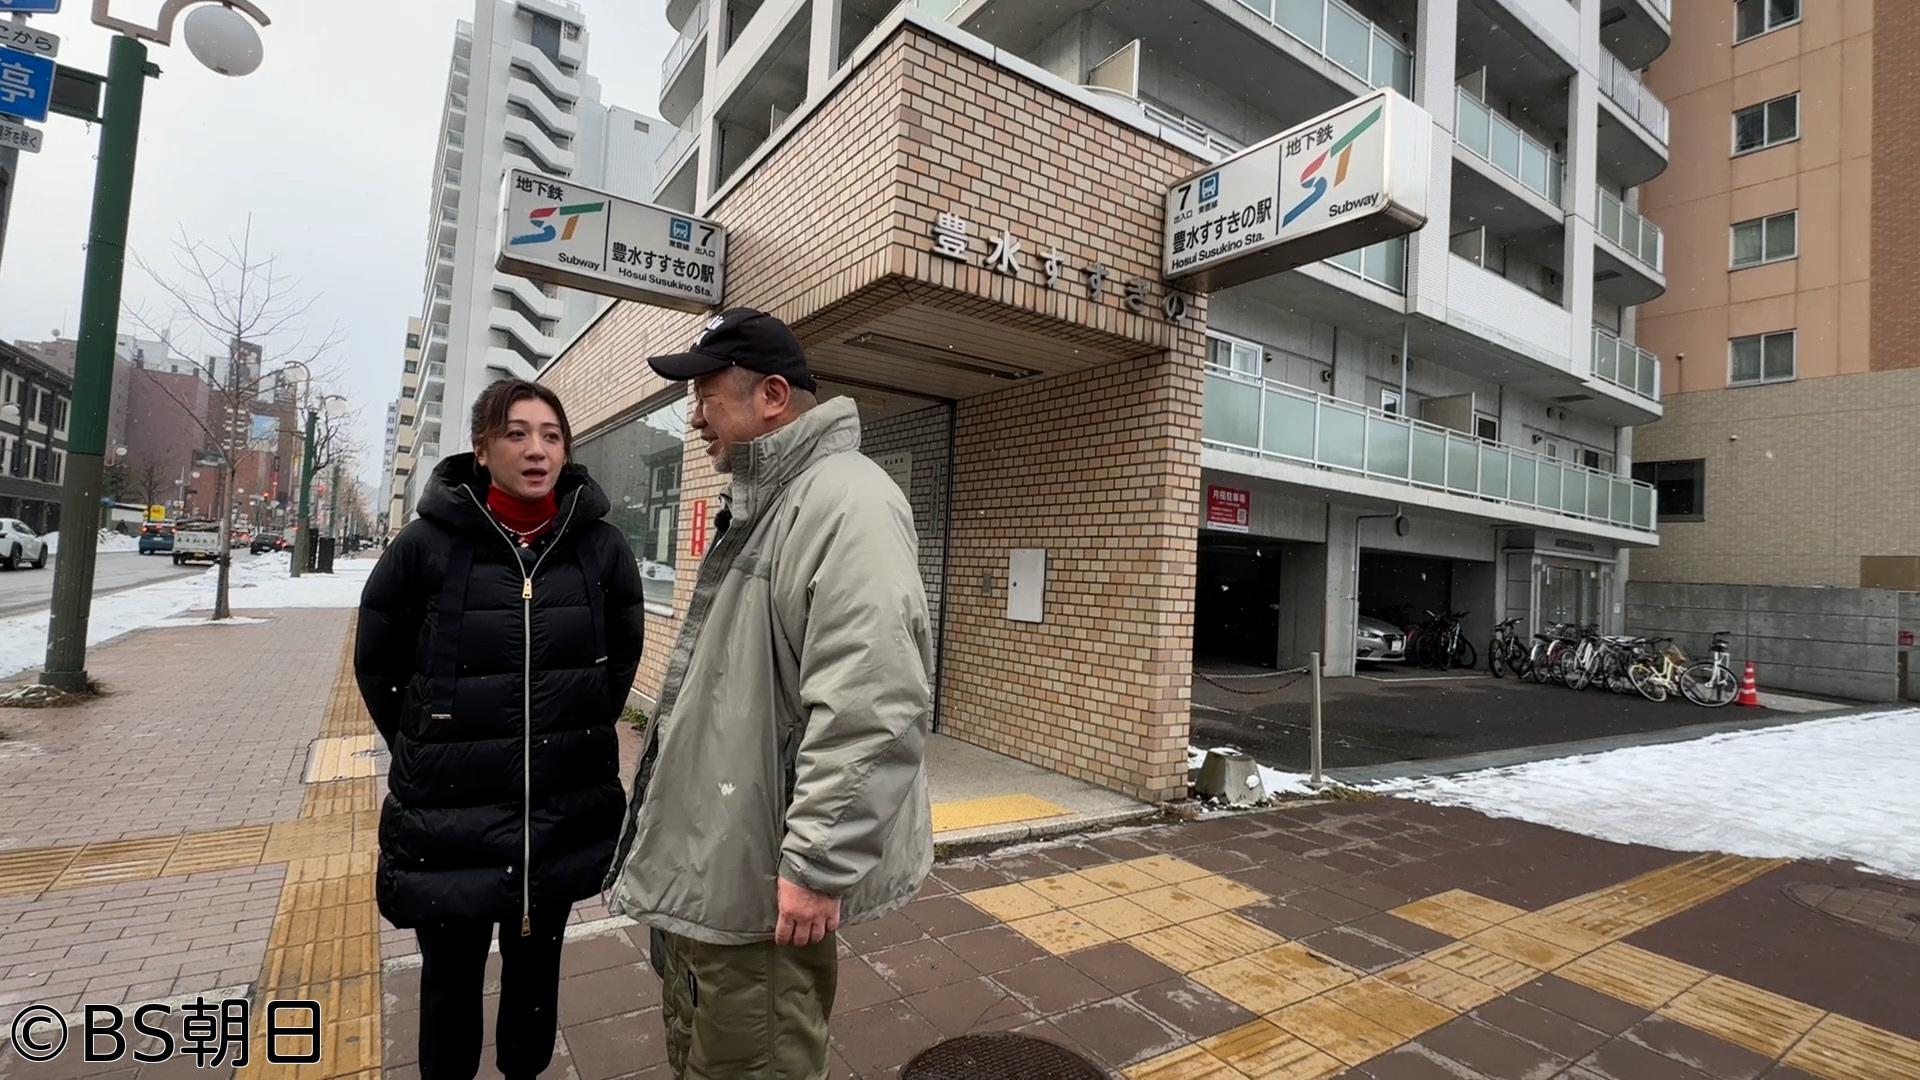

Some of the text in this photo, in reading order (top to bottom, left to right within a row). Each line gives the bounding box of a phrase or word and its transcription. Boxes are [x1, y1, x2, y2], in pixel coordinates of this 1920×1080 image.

[1285, 123, 1334, 158] 地下鉄
[515, 175, 564, 201] 地下鉄
[1178, 184, 1191, 211] 7
[1329, 192, 1379, 218] Subway
[699, 226, 716, 247] 7
[1172, 197, 1272, 255] 豊水すすきの駅
[1198, 239, 1243, 261] Susukino
[1244, 232, 1265, 246] Sta.
[558, 252, 600, 272] Subway
[612, 241, 715, 285] 豊水すすきの駅
[932, 211, 1188, 322] 豊水すすきの
[648, 273, 693, 293] Susukino
[694, 284, 713, 297] Sta.
